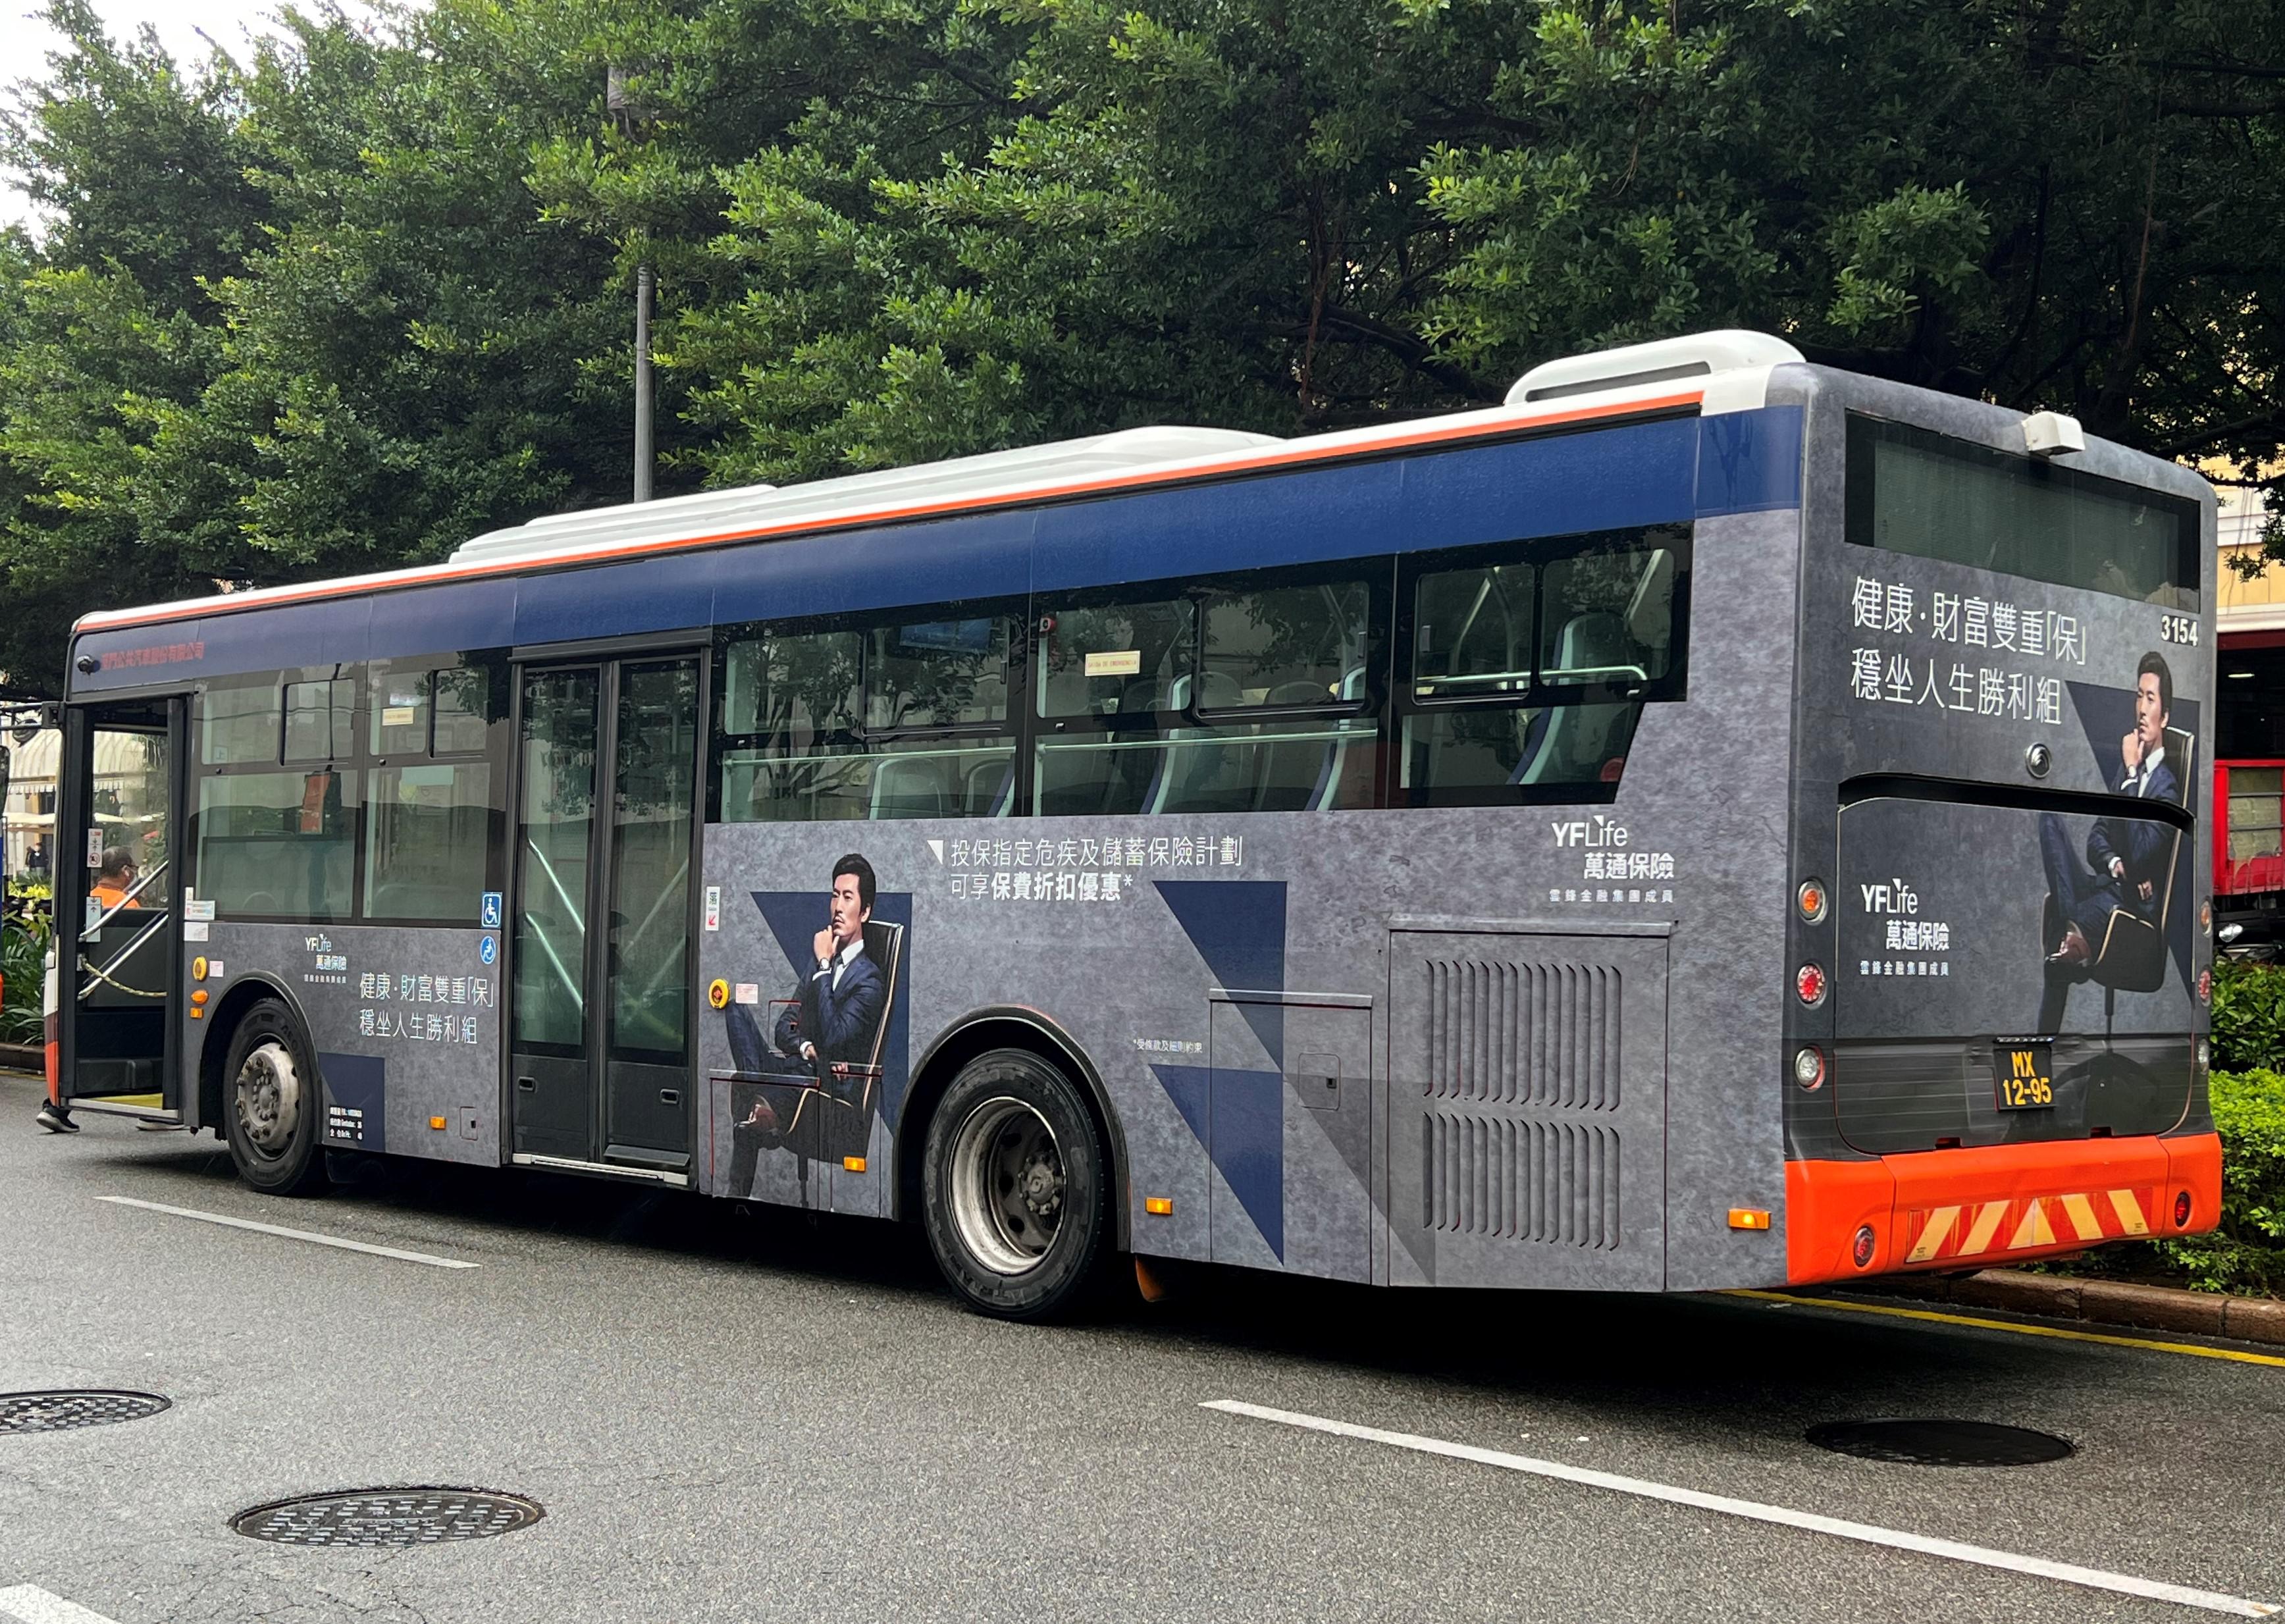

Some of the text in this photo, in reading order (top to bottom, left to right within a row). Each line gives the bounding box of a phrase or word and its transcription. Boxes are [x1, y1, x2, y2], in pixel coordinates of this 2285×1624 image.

[2160, 614, 2199, 646] 3154
[1850, 647, 2062, 725] 穩坐人生勝利組
[950, 835, 1244, 867] 投保指定危疾及儲蓄保險計劃
[1583, 852, 1675, 879] 萬通保險
[1885, 919, 1950, 951] 萬通保險
[359, 1008, 478, 1045] 穩坐人生勝利組
[2010, 1051, 2037, 1078] MX
[2002, 1077, 2053, 1107] 12-95
